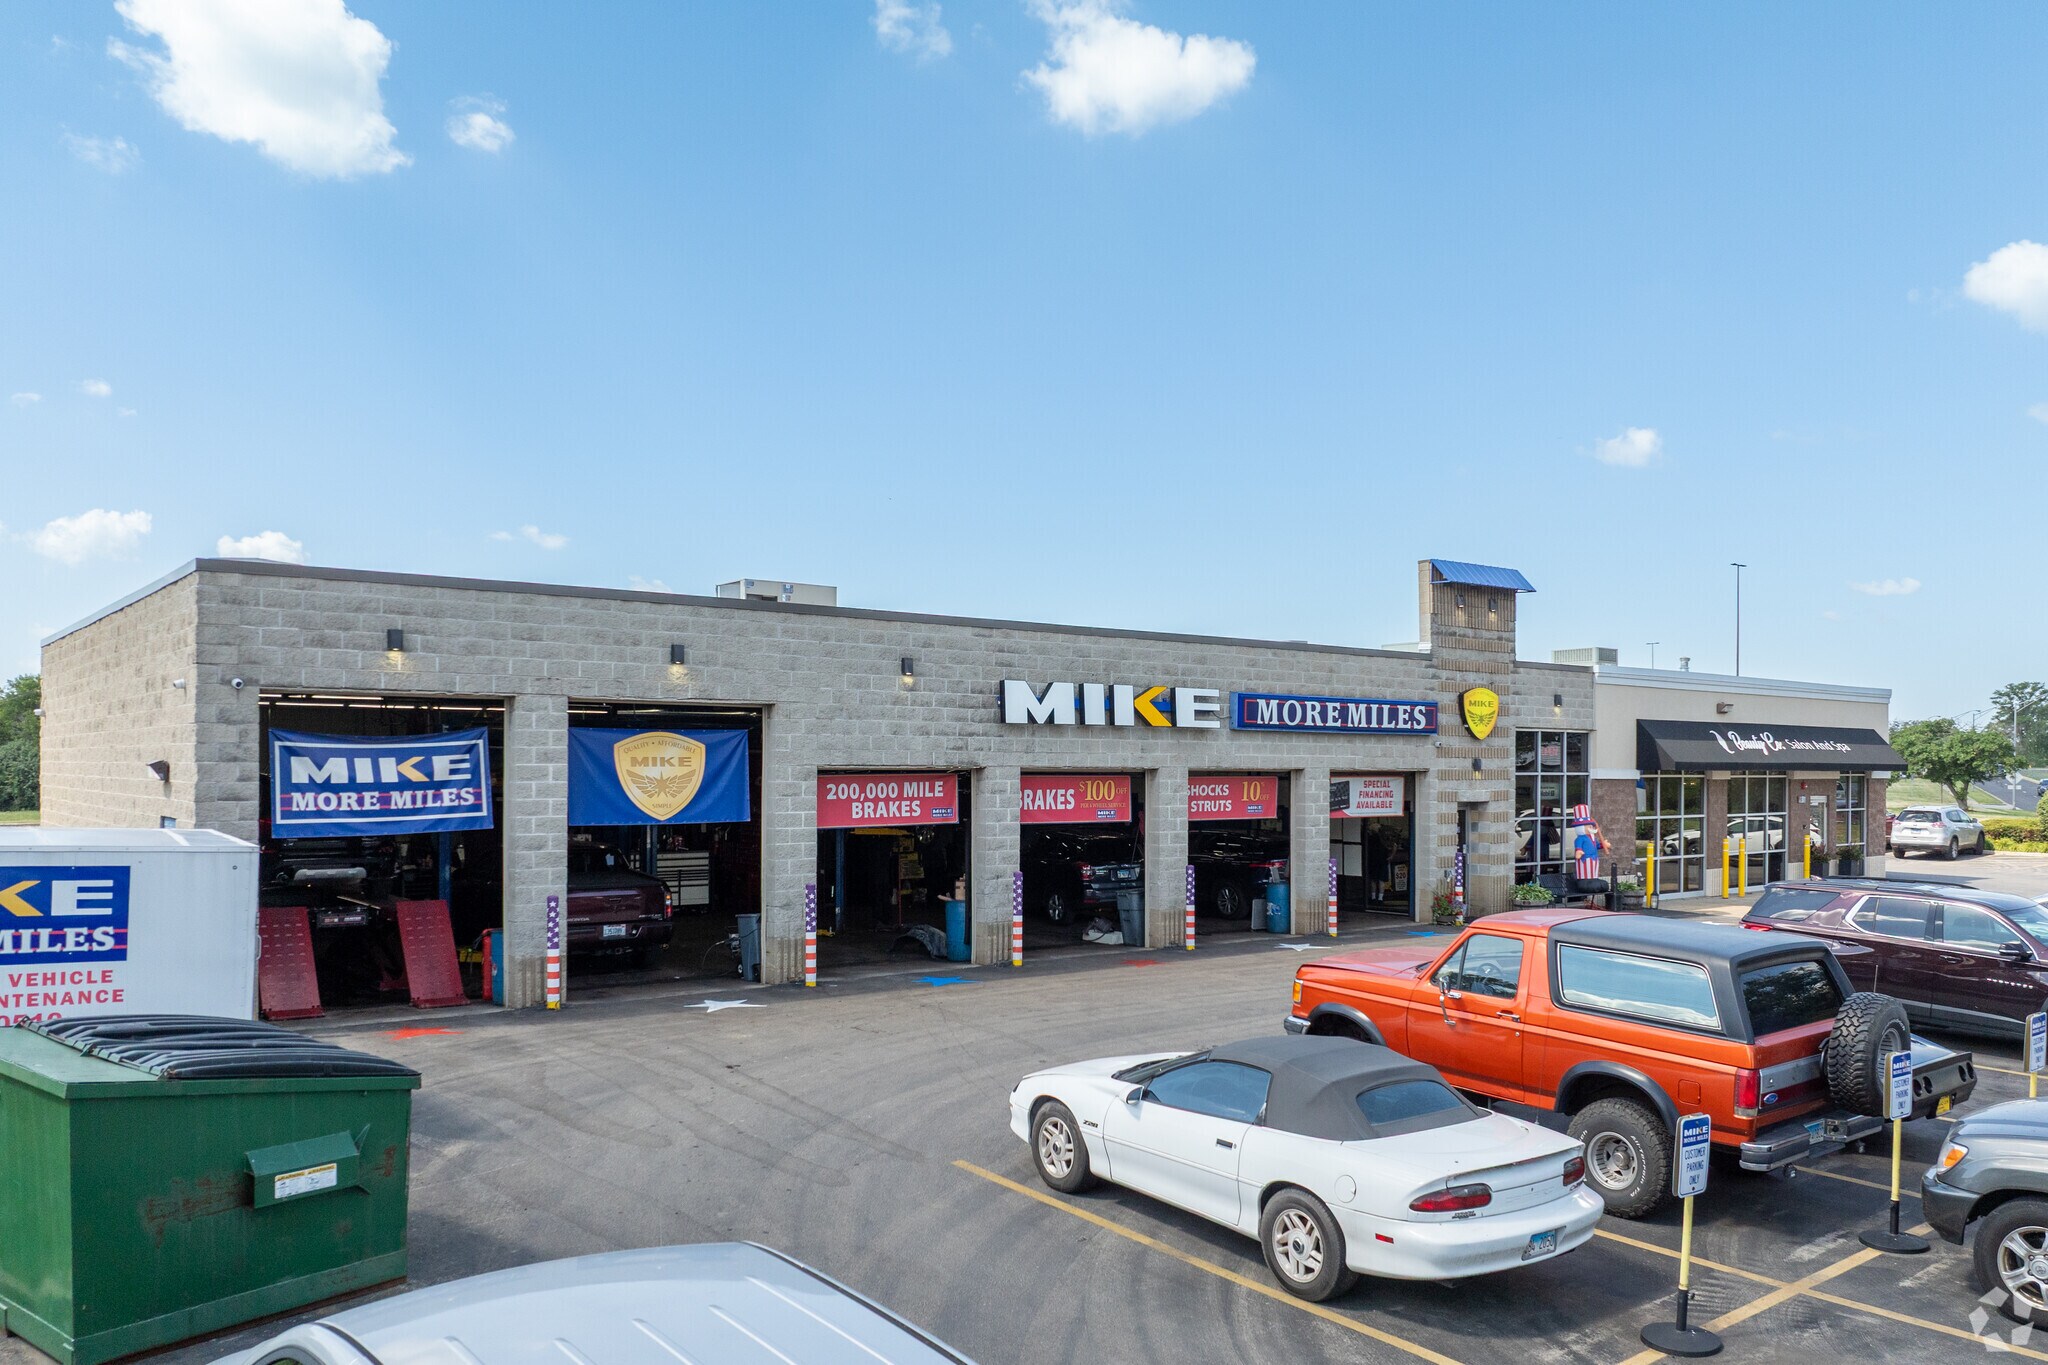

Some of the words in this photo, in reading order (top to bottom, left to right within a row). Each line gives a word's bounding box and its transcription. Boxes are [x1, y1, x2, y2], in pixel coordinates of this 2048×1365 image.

[1001, 679, 1221, 728] MIKE
[1468, 700, 1495, 708] MIKE
[1256, 699, 1341, 728] MORE
[1347, 703, 1427, 730] MILES
[623, 740, 650, 754] QUALITY
[657, 740, 696, 754] AFFORDABLE
[1727, 731, 1769, 755] Beauty
[1785, 739, 1815, 751] Salon
[1812, 740, 1835, 751] And
[1830, 741, 1852, 753] Spa
[290, 753, 472, 784] MIKE
[630, 756, 692, 768] MIKE
[826, 782, 899, 801] 200,000
[903, 781, 944, 798] MILE
[1079, 780, 1116, 801] $100
[1363, 780, 1391, 788] SPECIAL
[290, 791, 381, 812] MORE
[390, 787, 476, 810] MILES
[1019, 788, 1076, 810] RAKES
[1359, 790, 1394, 798] FINANCING
[851, 800, 922, 819] BRAKES
[1190, 800, 1233, 812] STRUTS
[1356, 800, 1393, 809] AVAILABLE
[8, 970, 114, 988] VEHICLE
[1683, 1125, 1709, 1137] MIKE
[1684, 1147, 1706, 1160] CUSTOMER
[1686, 1160, 1705, 1173] PARKING
[1689, 1174, 1700, 1186] ONLY
